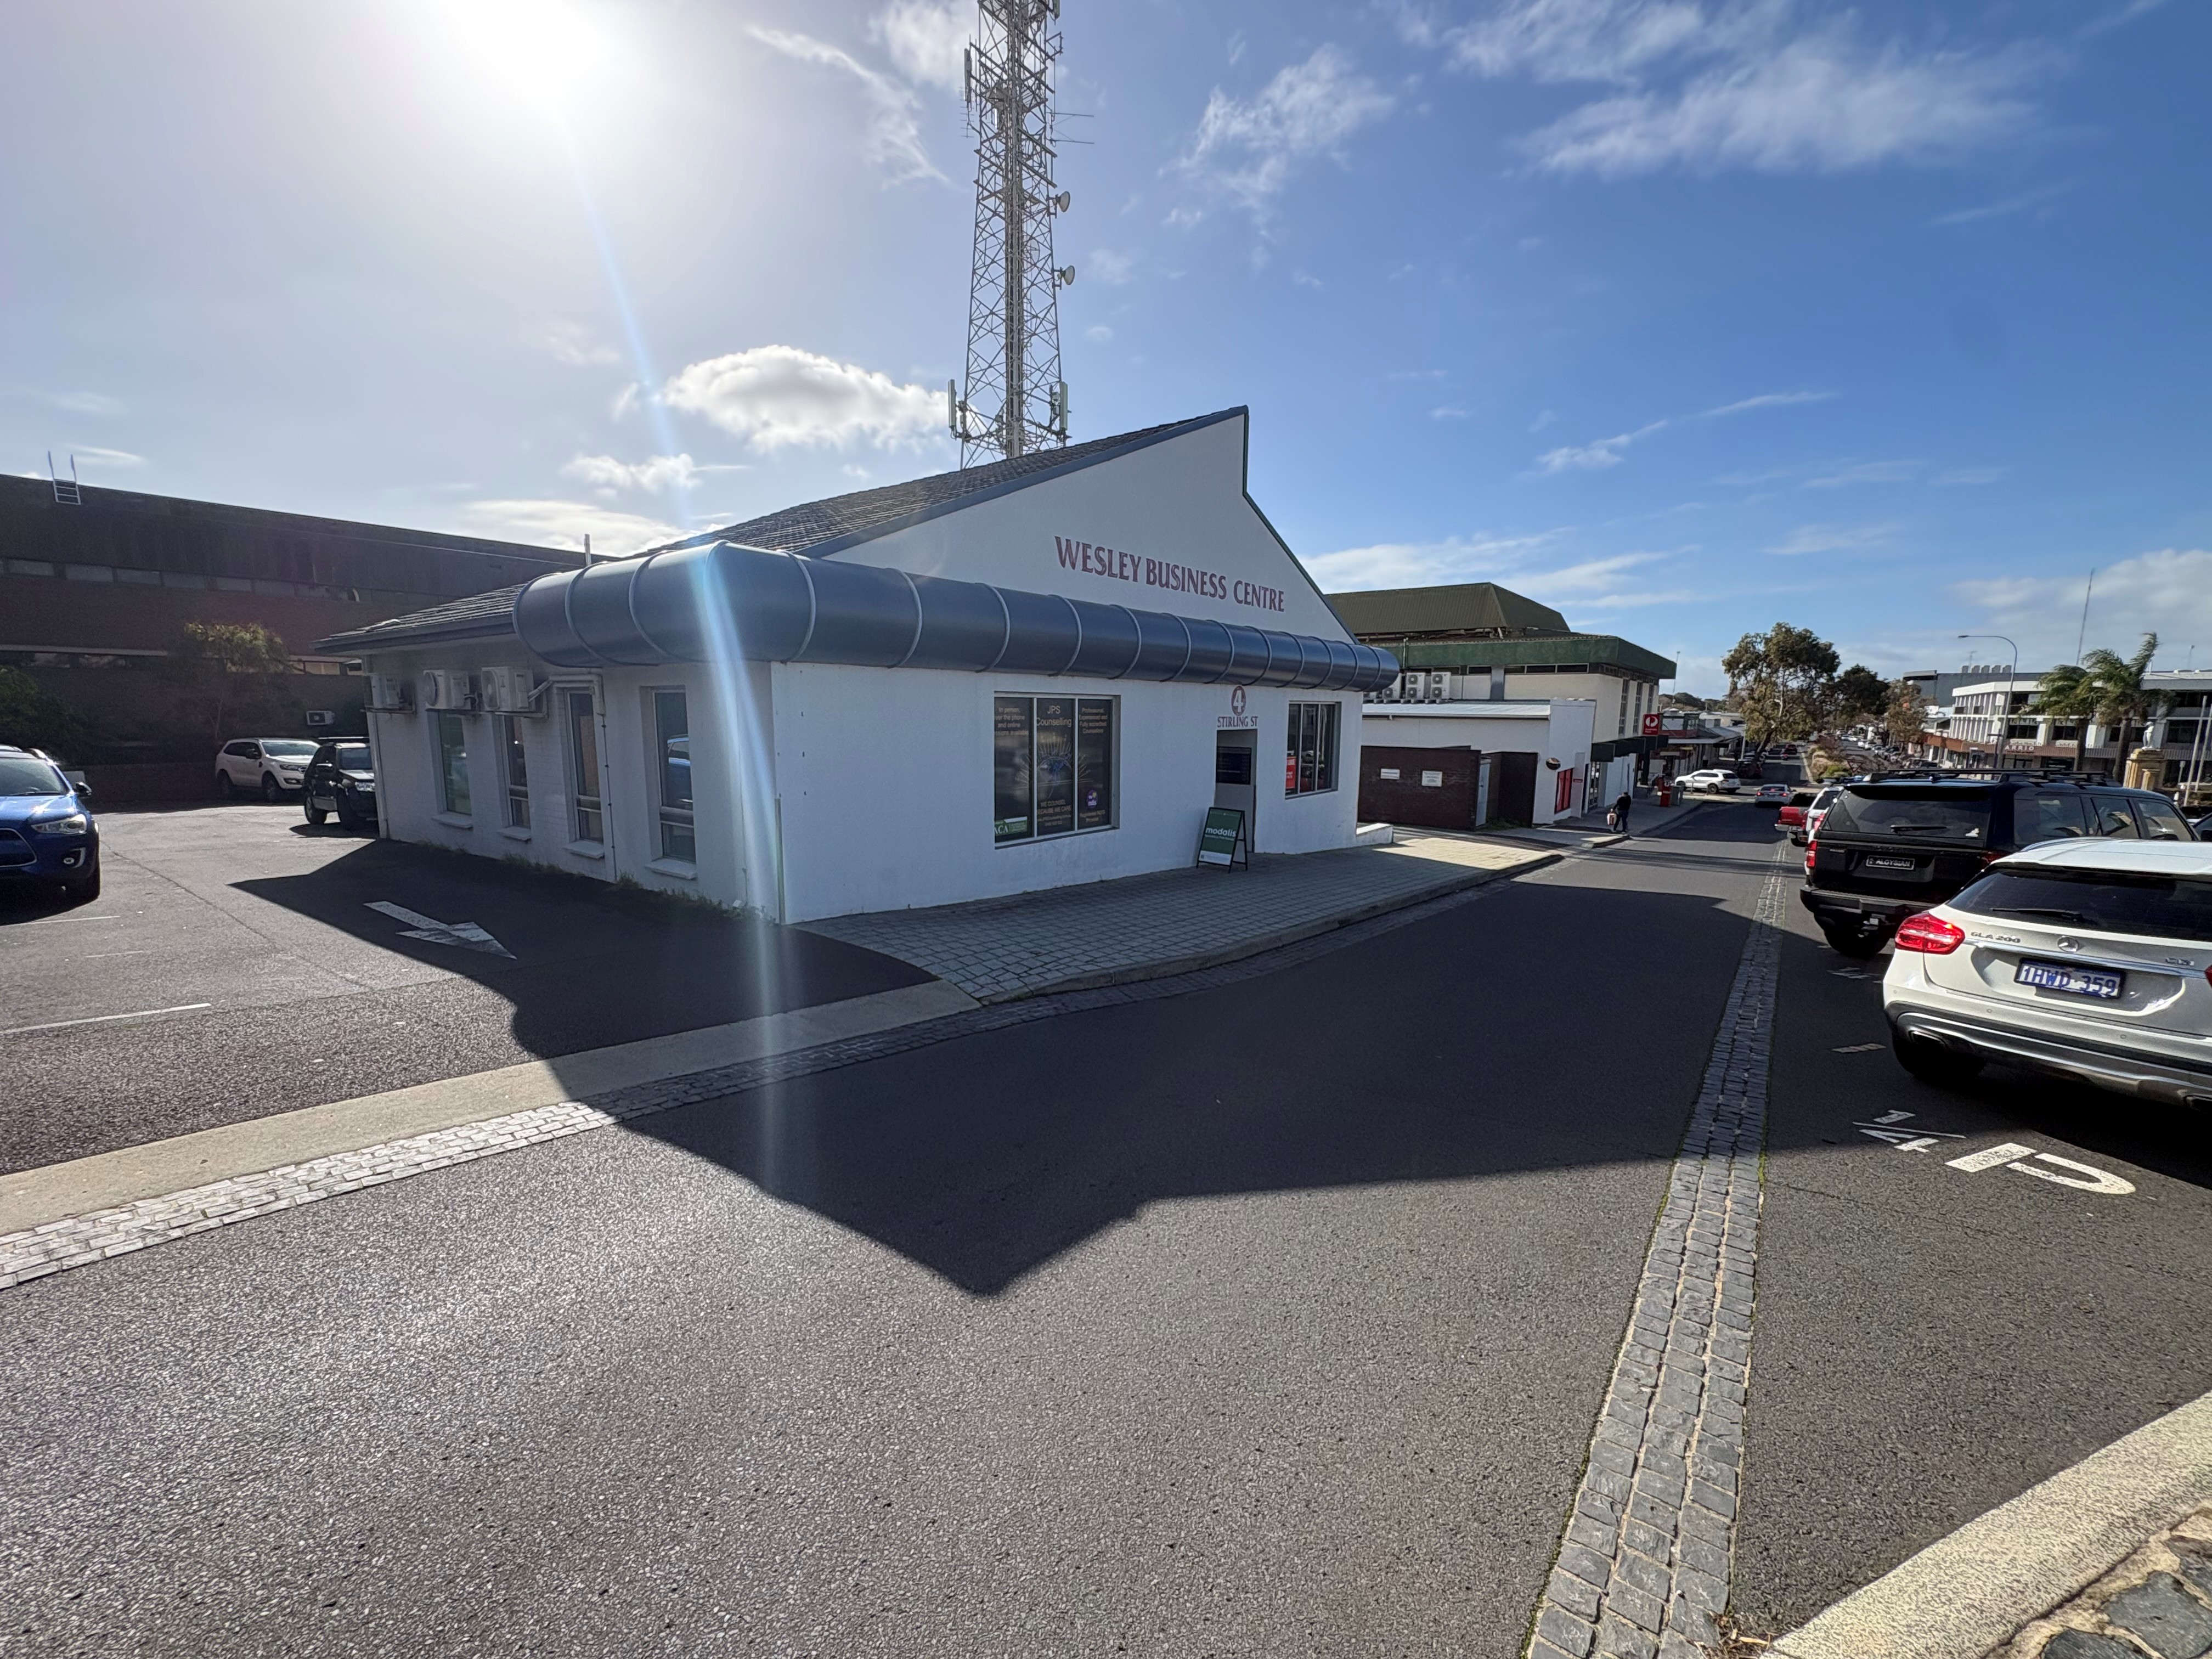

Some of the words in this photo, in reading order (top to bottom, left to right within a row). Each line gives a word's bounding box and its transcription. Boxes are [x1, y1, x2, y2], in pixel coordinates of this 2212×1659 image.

[1054, 536, 1142, 582] WESLEY
[1146, 558, 1227, 600] BUSINESS
[1233, 580, 1285, 612] CENTRE
[1233, 690, 1244, 713] 4
[1047, 706, 1060, 714] JPS
[1037, 717, 1071, 727] Counselling
[1217, 716, 1248, 727] STIRLING
[1250, 716, 1258, 727] ST
[1205, 827, 1237, 837] modalis
[1971, 932, 1995, 941] GLA
[1996, 934, 2021, 943] 200
